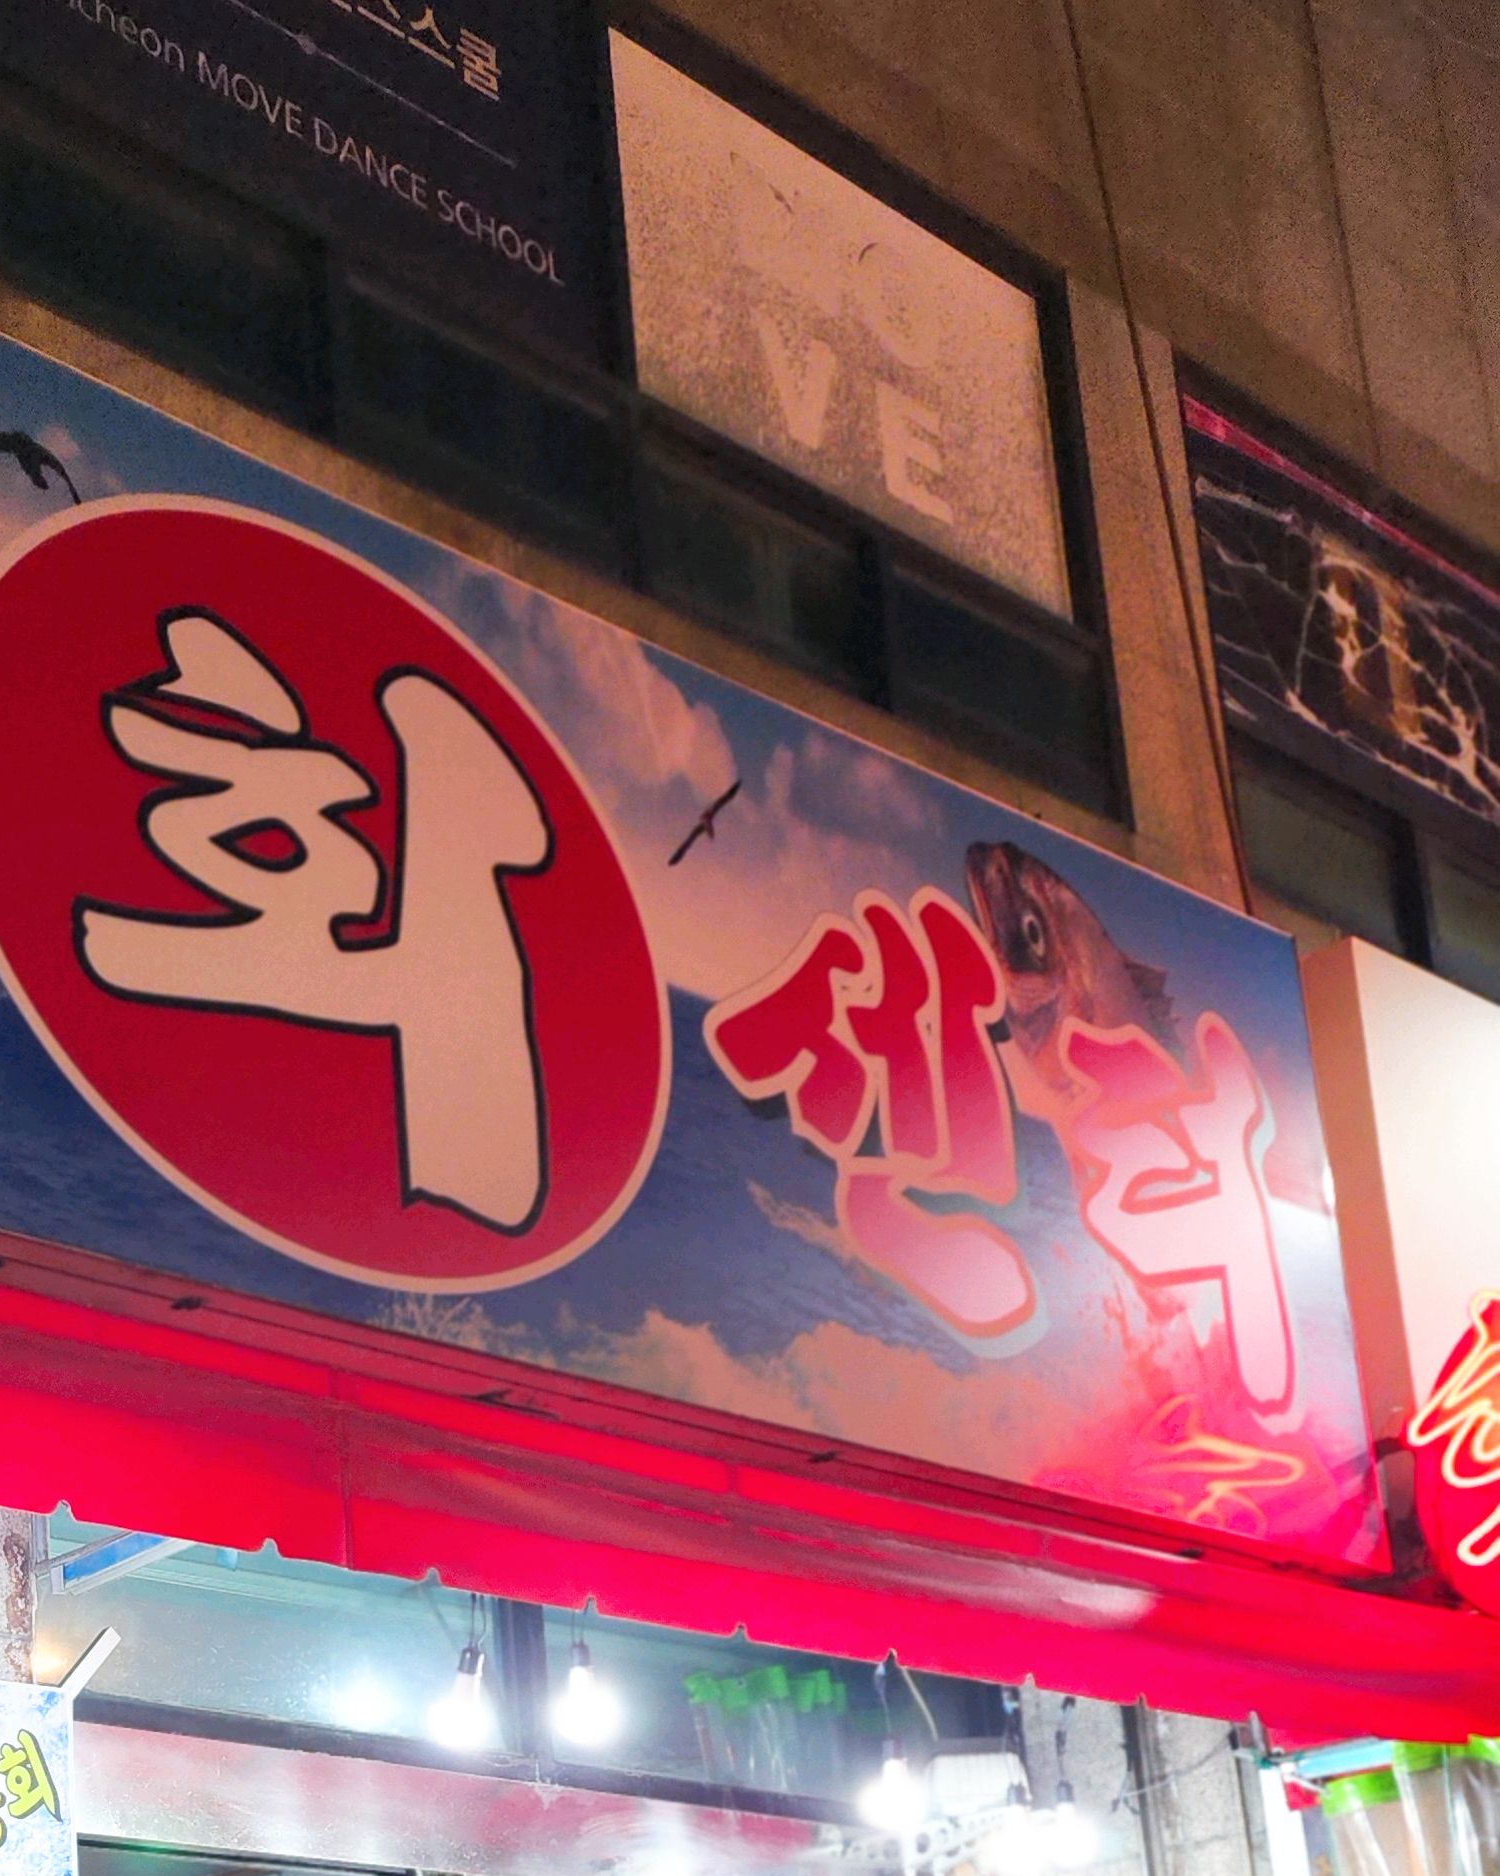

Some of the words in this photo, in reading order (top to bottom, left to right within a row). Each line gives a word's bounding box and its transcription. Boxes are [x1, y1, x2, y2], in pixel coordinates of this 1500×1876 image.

[69, 0, 185, 72] cheon
[198, 51, 302, 138] MOVE
[314, 116, 428, 210] DANCE
[437, 189, 566, 287] SCHOOL
[72, 604, 554, 1237] 회
